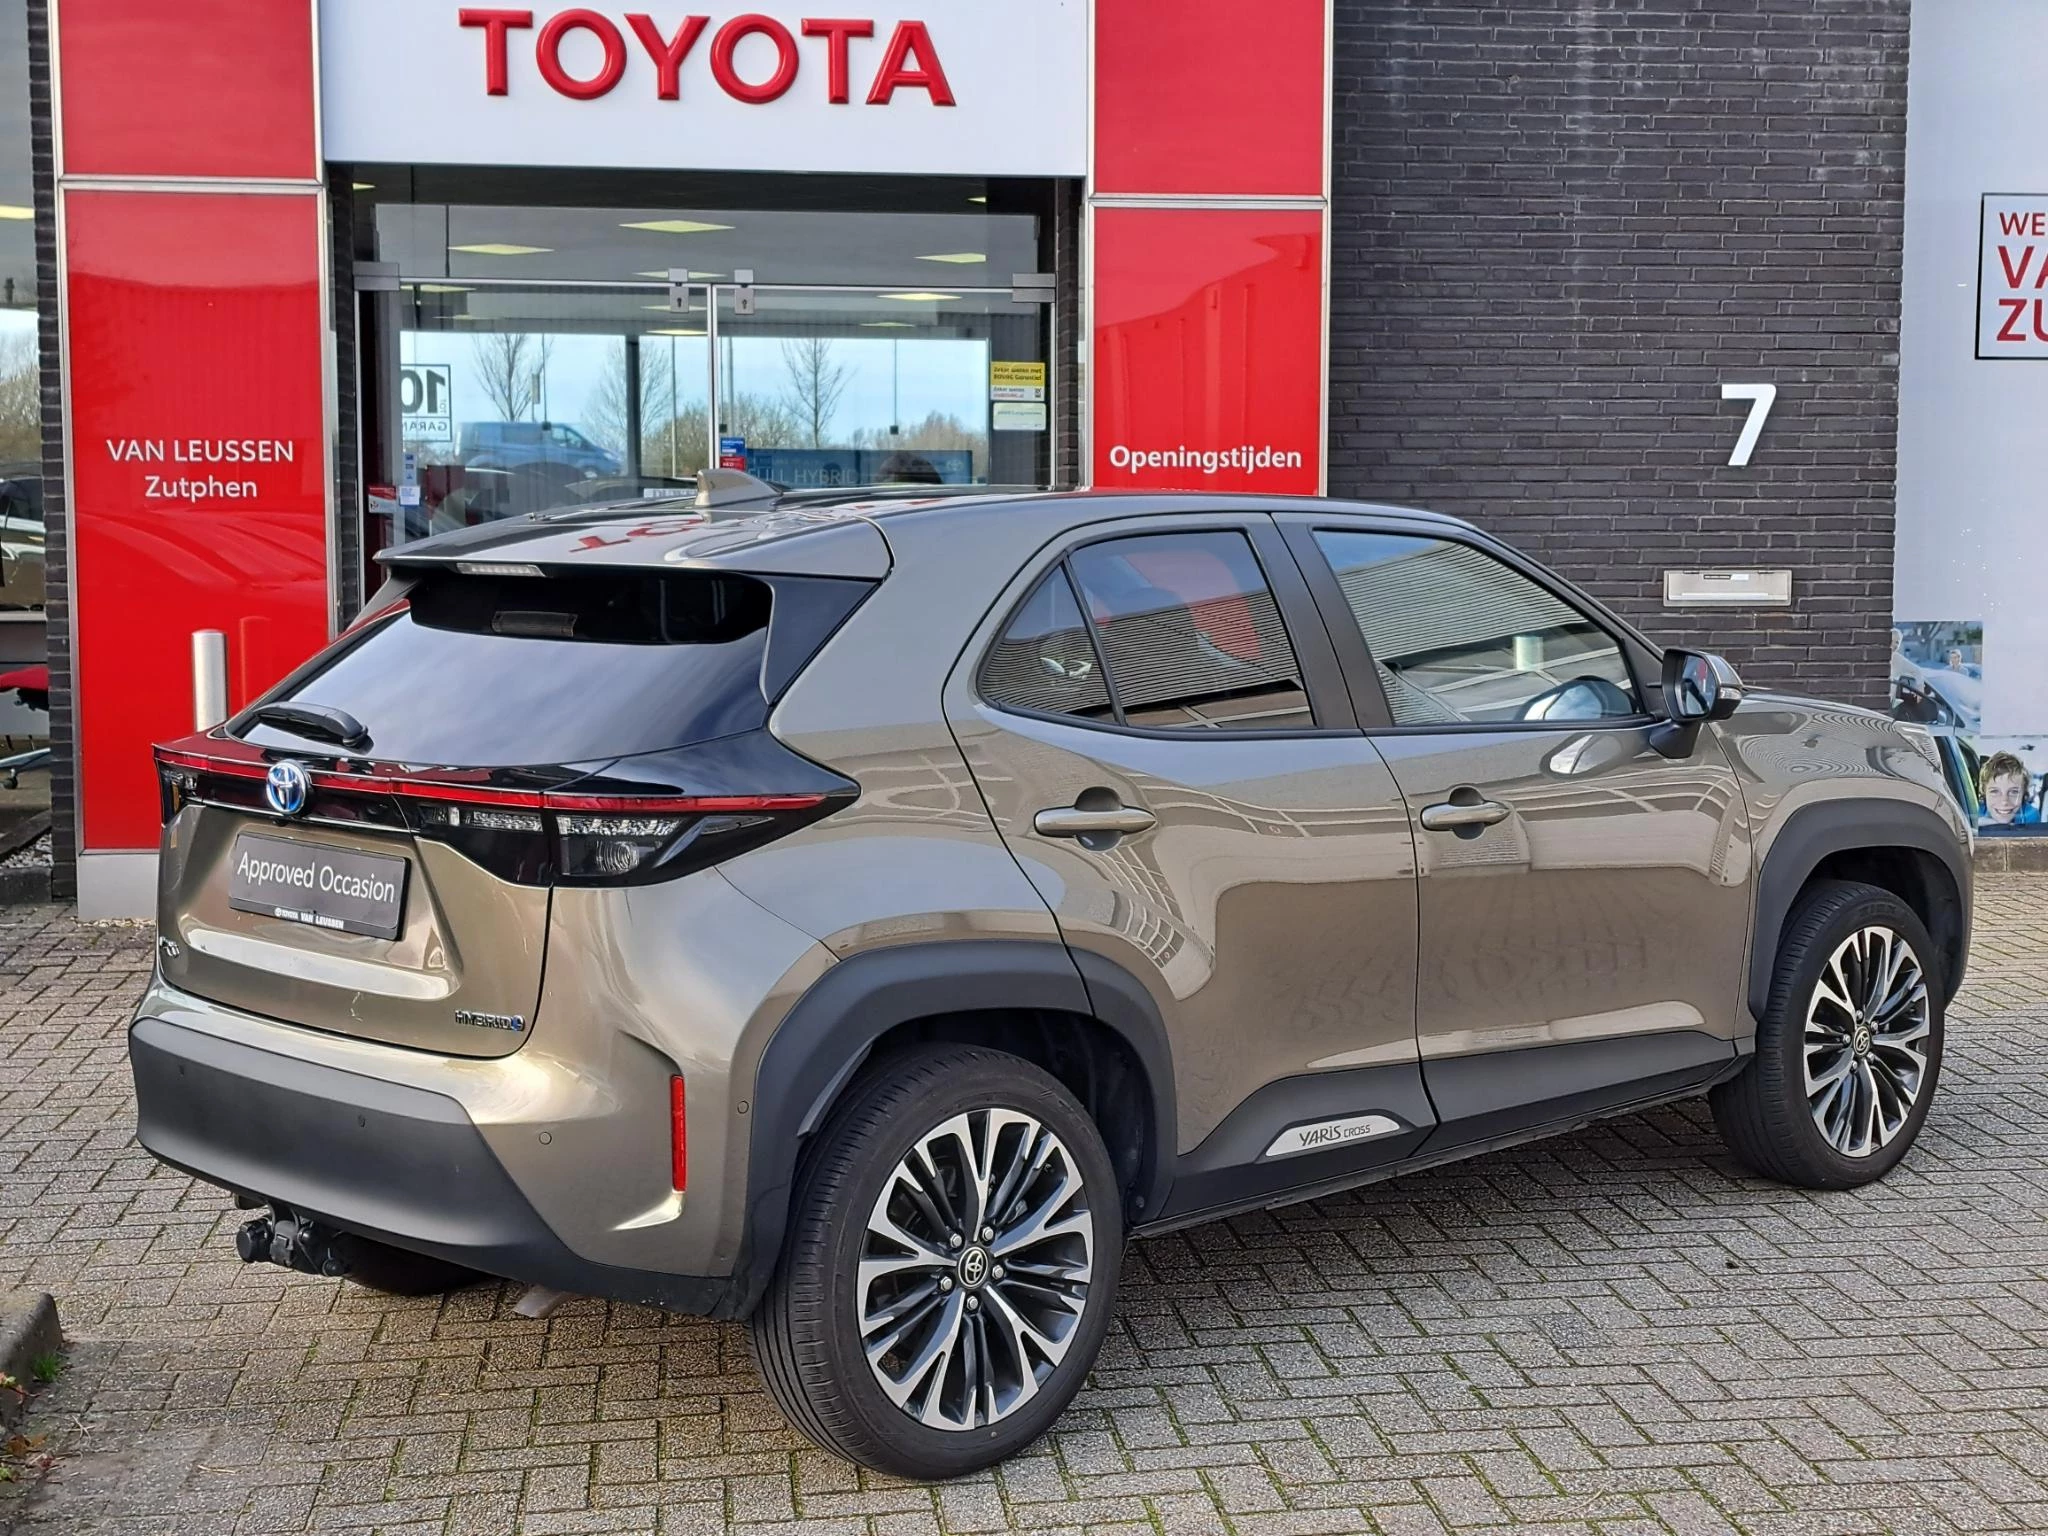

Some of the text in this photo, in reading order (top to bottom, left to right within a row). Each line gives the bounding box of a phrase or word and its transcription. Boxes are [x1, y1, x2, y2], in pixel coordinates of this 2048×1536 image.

[458, 7, 957, 107] TOYOTA
[1720, 383, 1777, 467] 7
[106, 439, 293, 463] VAN LEUSSEN
[1109, 445, 1302, 474] Openingstijden
[144, 475, 258, 503] Zutphen
[237, 850, 395, 903] Approved Occasion
[454, 1009, 512, 1030] HYBRID
[1343, 1124, 1371, 1139] CROSS
